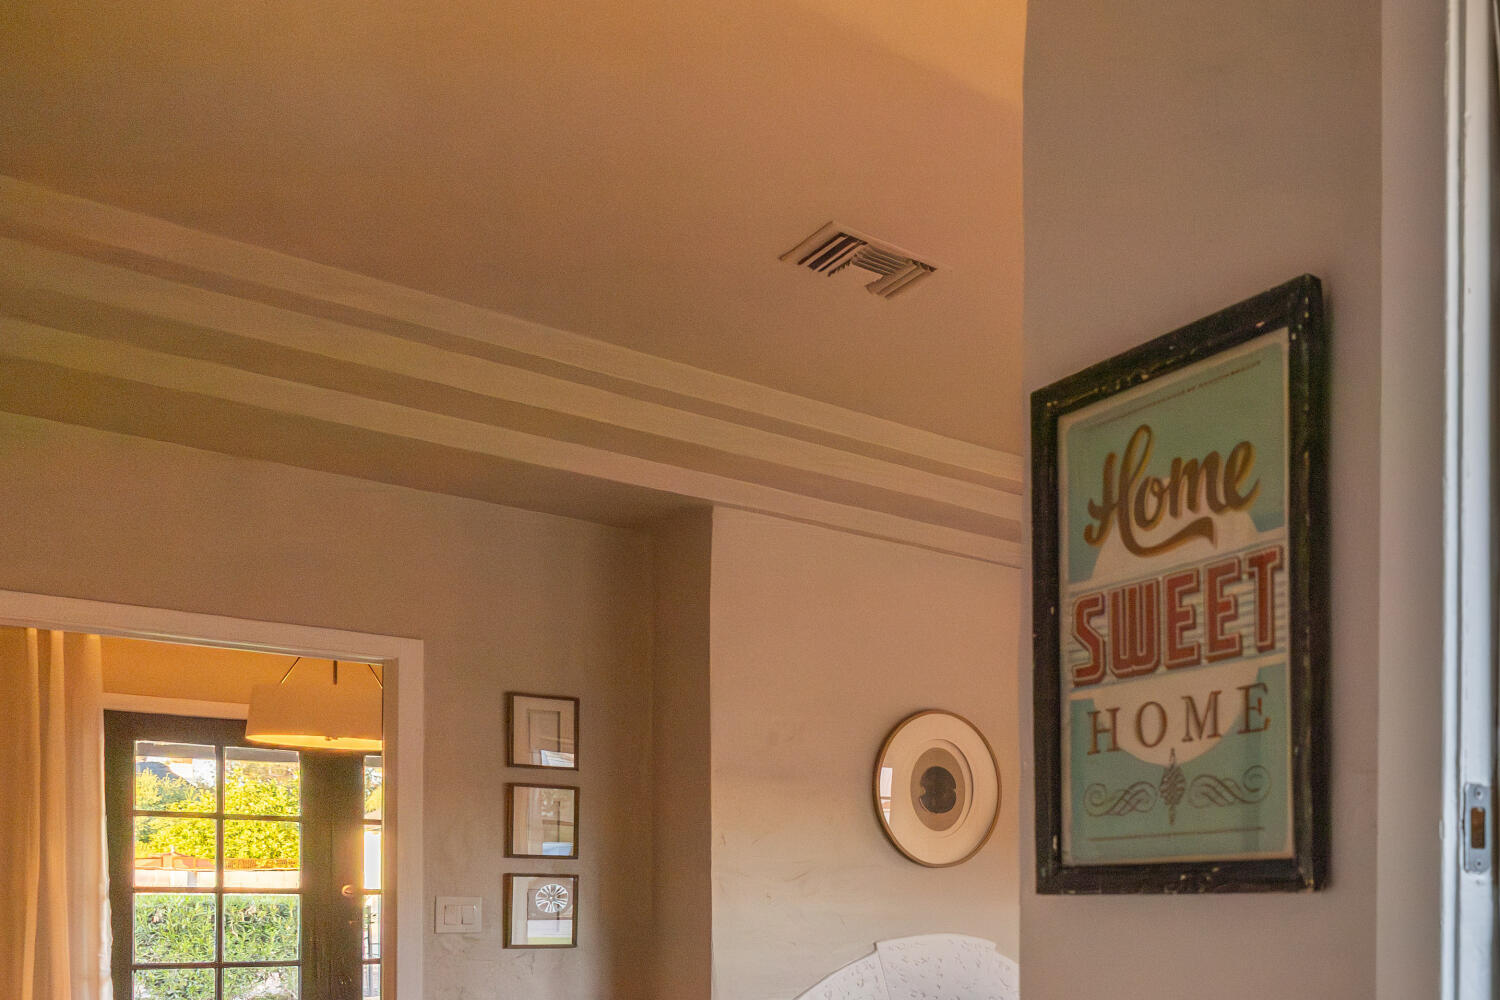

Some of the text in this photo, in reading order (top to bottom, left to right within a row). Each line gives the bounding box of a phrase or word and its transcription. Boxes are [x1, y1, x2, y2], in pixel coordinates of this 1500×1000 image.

[1085, 425, 1260, 557] Home
[1073, 546, 1284, 688] SWEET
[1087, 684, 1271, 755] HOME
